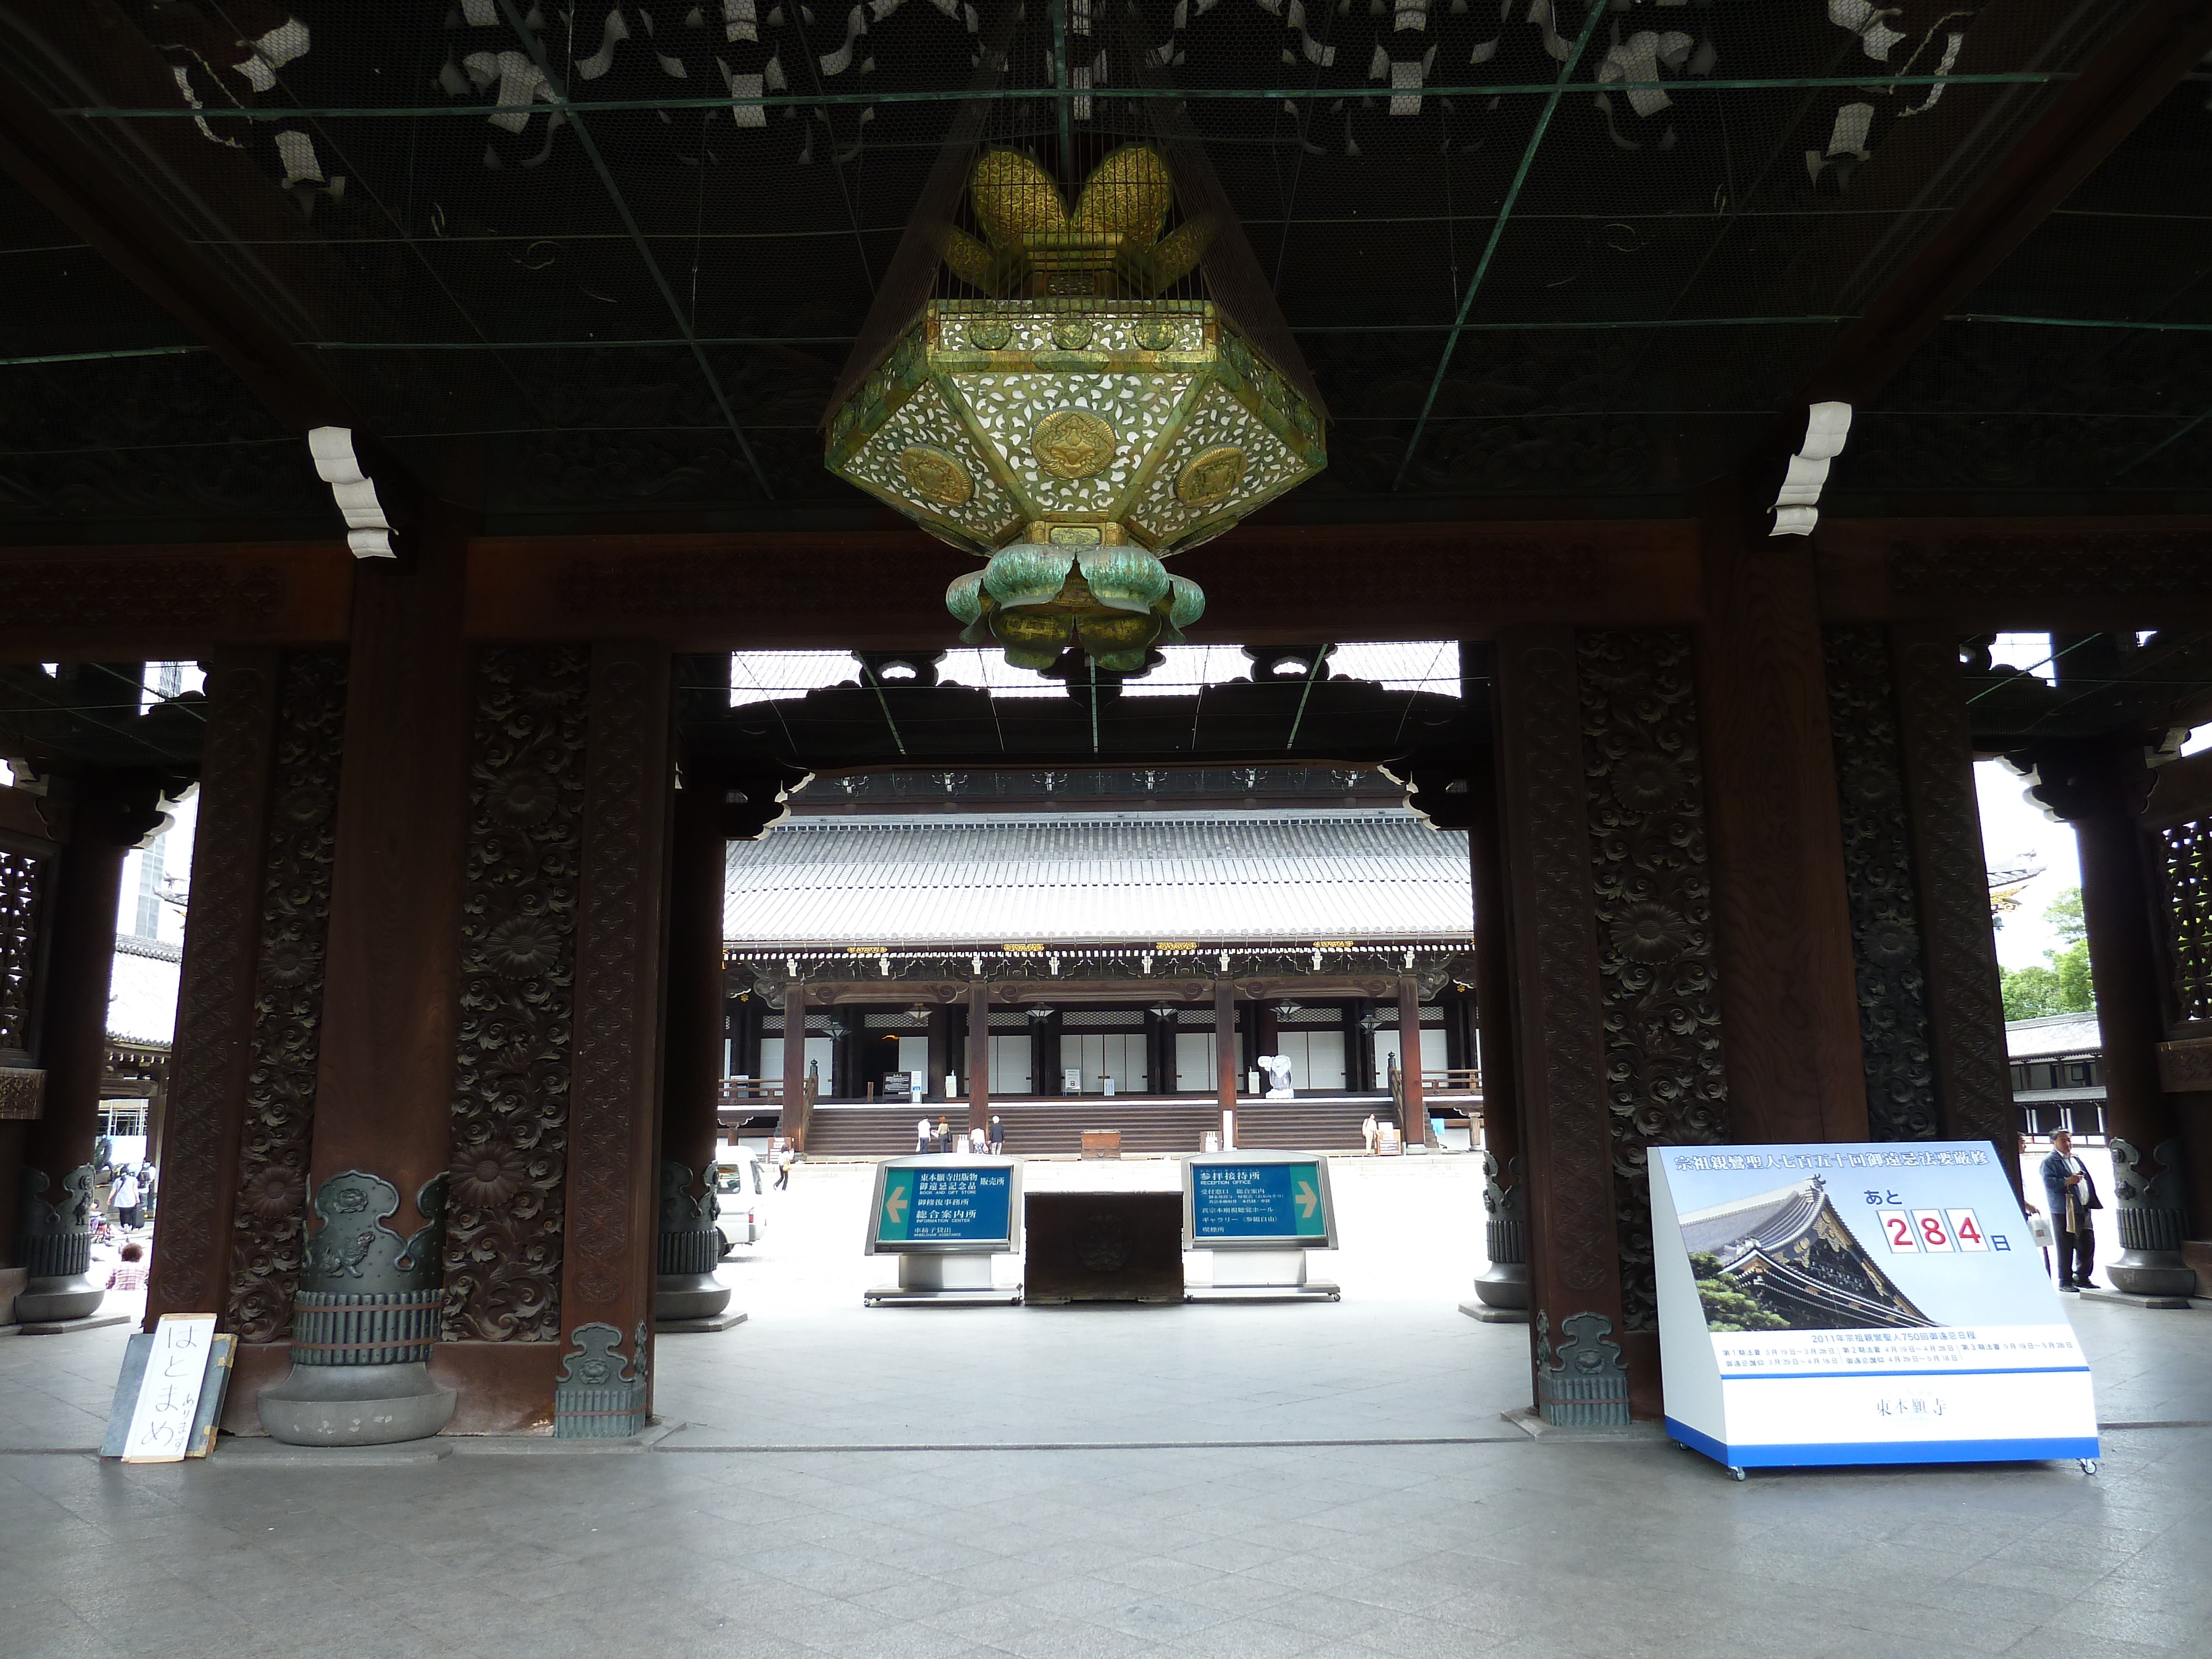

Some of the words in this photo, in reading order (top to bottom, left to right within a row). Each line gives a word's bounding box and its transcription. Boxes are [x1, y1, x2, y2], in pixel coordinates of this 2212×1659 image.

[921, 1173, 978, 1182] 東本願寺出版物
[1200, 1172, 1260, 1180] 参拝接待所
[980, 1177, 1005, 1186] 販売所
[920, 1182, 976, 1191] 御遠忌記念品
[1864, 1190, 1903, 1205] あと
[916, 1209, 977, 1219] 総合案内所
[1887, 1217, 1981, 1245] 284
[1990, 1235, 2012, 1251] 日
[141, 1325, 199, 1447] はとまめ
